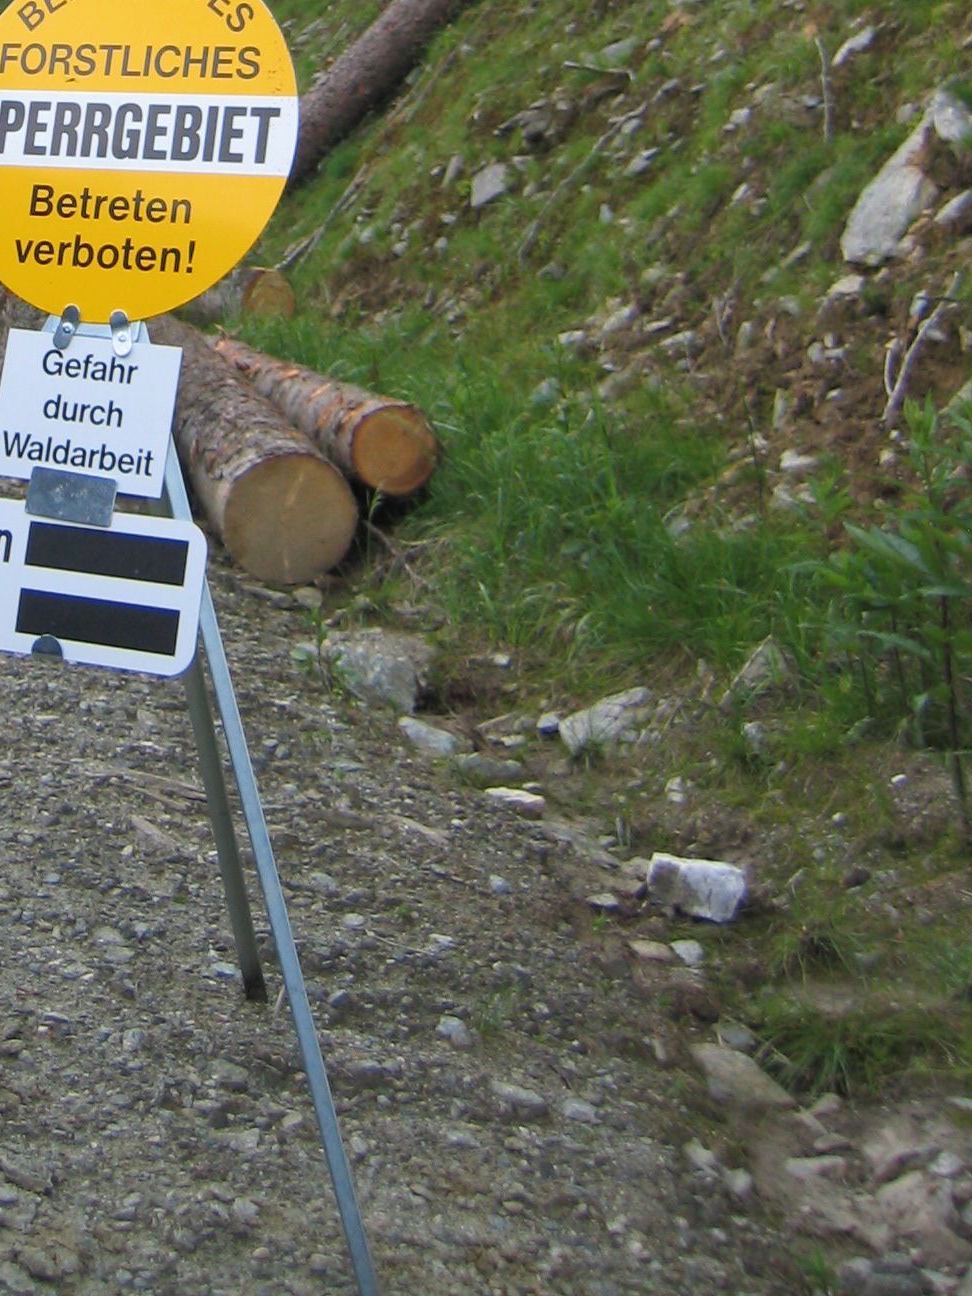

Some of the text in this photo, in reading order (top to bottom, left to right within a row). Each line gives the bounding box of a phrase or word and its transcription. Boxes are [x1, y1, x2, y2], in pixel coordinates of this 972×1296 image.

[29, 184, 192, 224] Betreten
[15, 235, 197, 274] verboten!
[42, 349, 138, 385] Gefahr
[42, 394, 124, 427] durch
[3, 431, 154, 477] Waldarbeit
